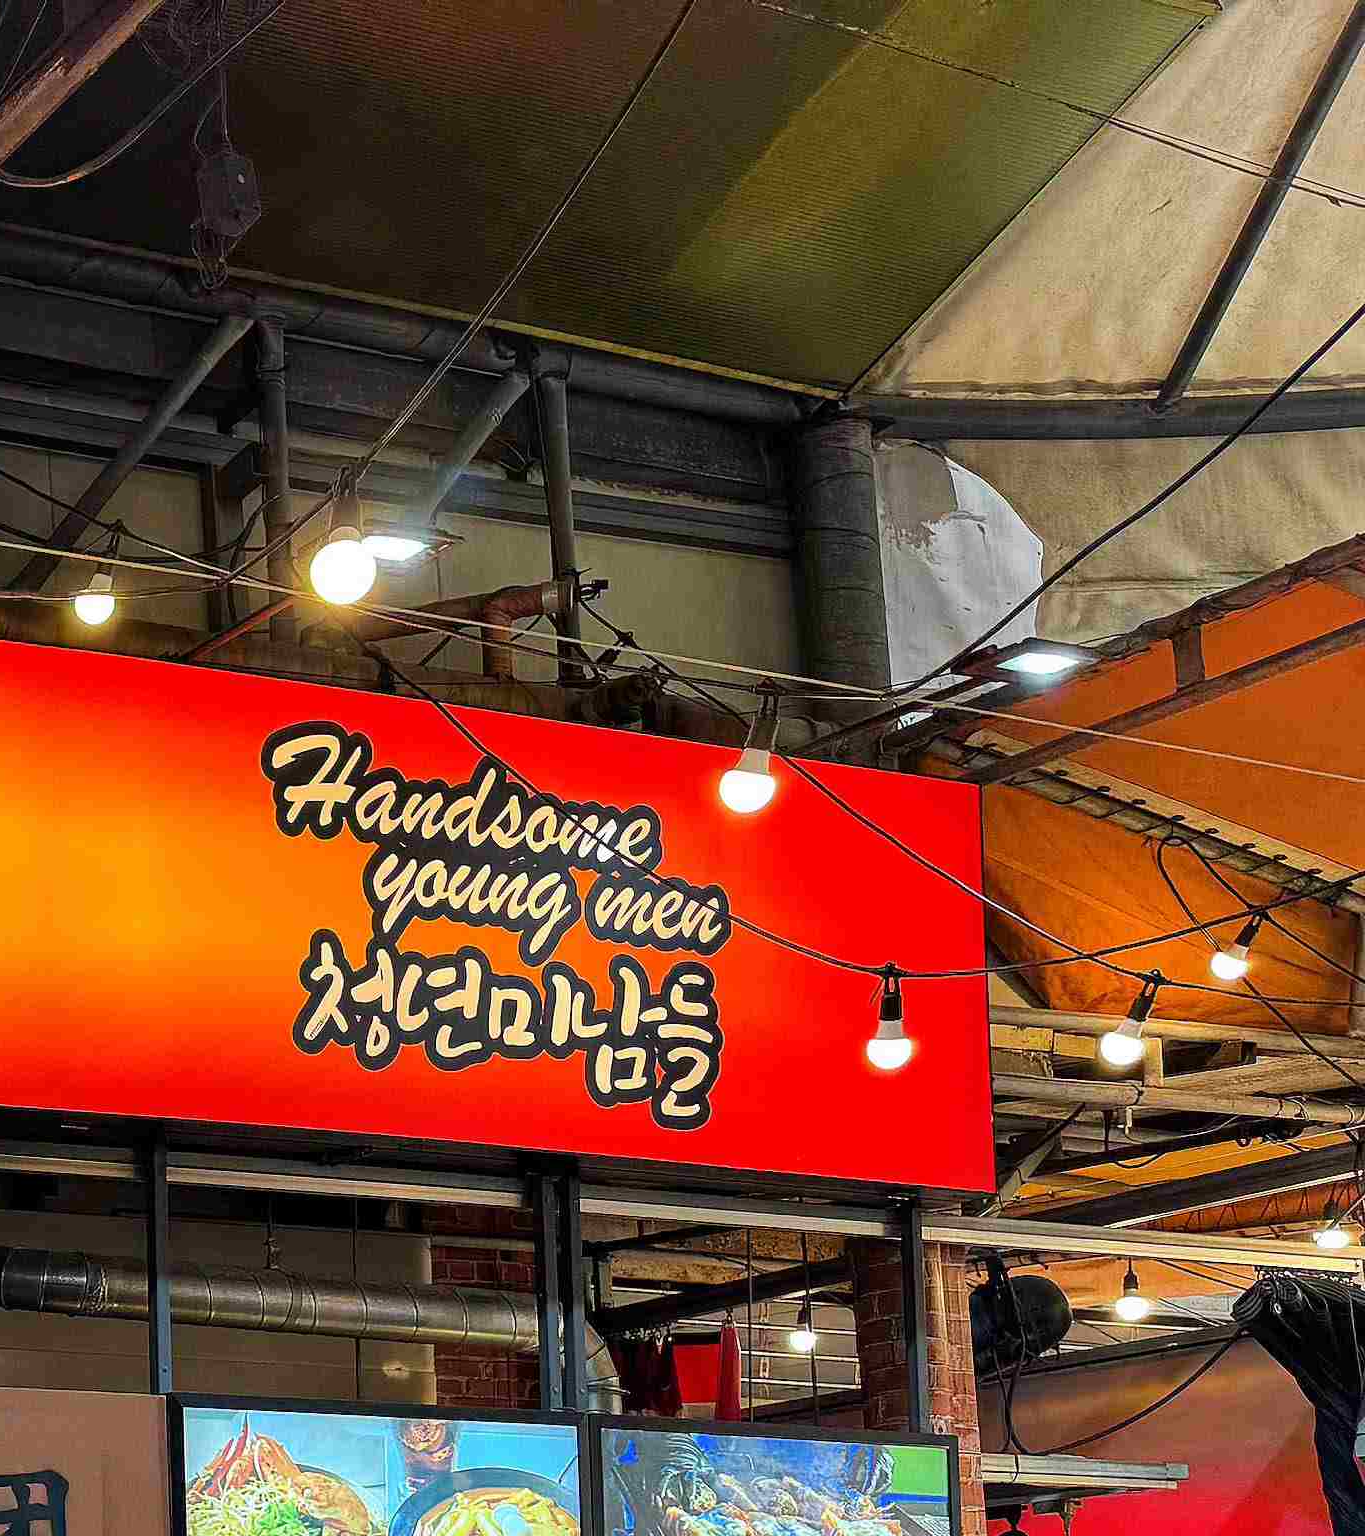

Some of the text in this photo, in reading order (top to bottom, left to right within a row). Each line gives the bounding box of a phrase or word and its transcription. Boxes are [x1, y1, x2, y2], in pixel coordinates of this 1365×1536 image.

[271, 734, 653, 866] Handsome
[372, 853, 722, 954] young men
